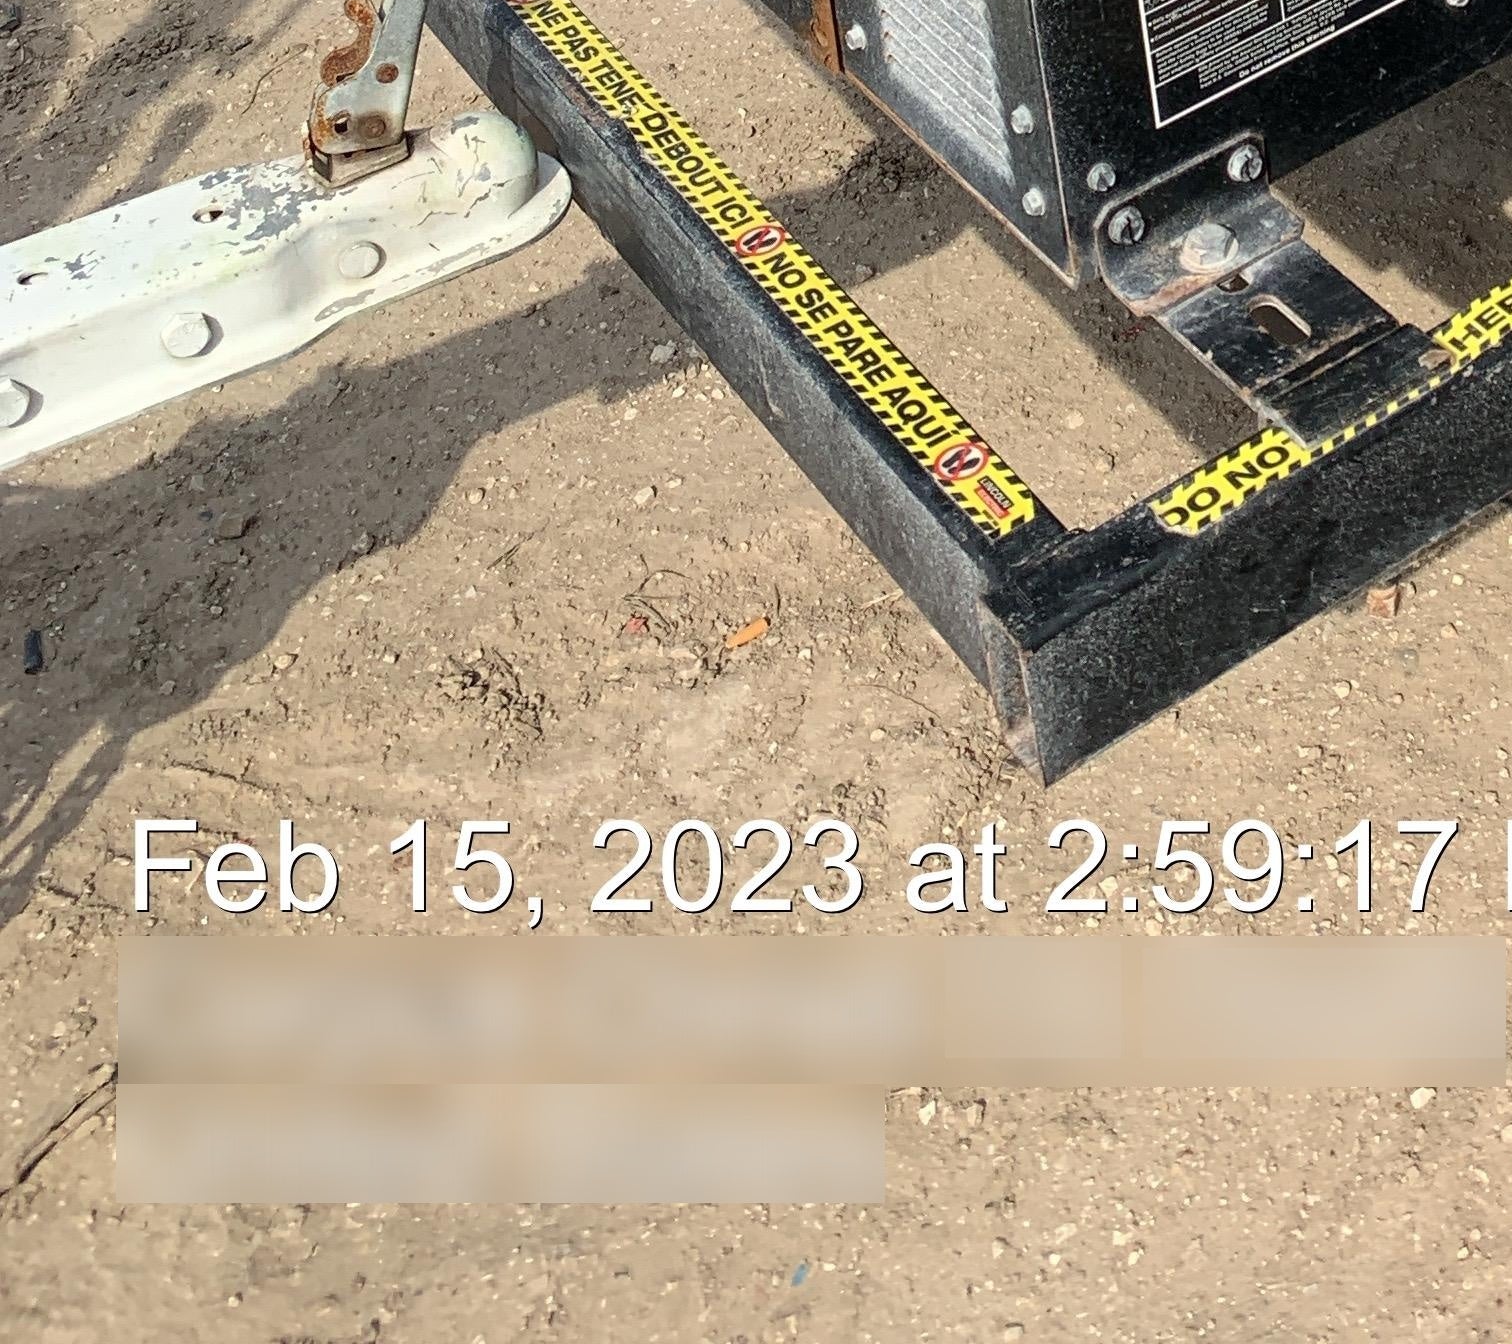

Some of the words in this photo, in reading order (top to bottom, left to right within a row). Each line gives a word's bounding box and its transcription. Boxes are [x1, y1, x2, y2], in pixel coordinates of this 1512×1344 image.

[532, 0, 570, 30] NE
[554, 24, 600, 63] PAS
[587, 59, 660, 112] TENE
[639, 112, 729, 198] DEBOUT
[711, 193, 756, 230] ICI
[761, 250, 808, 290] NO
[793, 286, 840, 325] SE
[821, 319, 896, 388] PARE
[981, 477, 1012, 510] LINCOLN
[1228, 444, 1293, 492] NO
